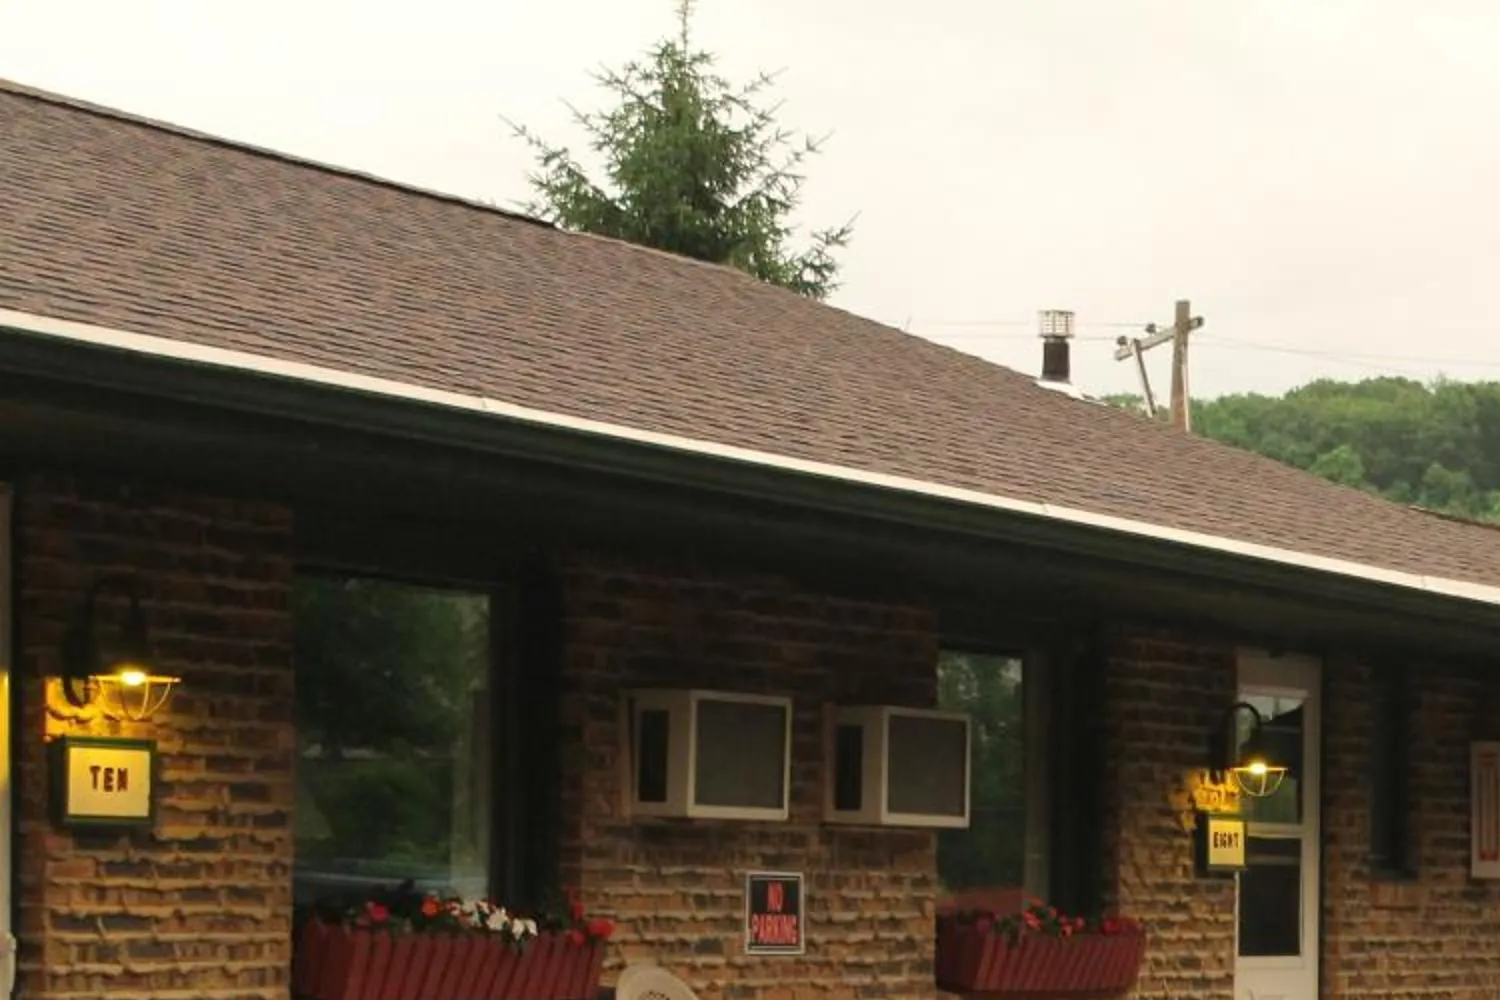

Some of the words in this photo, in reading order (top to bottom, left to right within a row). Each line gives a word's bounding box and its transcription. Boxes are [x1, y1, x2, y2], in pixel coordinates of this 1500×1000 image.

[89, 765, 129, 792] TEN
[1213, 831, 1239, 849] EIGHT
[767, 881, 784, 912] NO
[751, 913, 798, 945] PARKING
